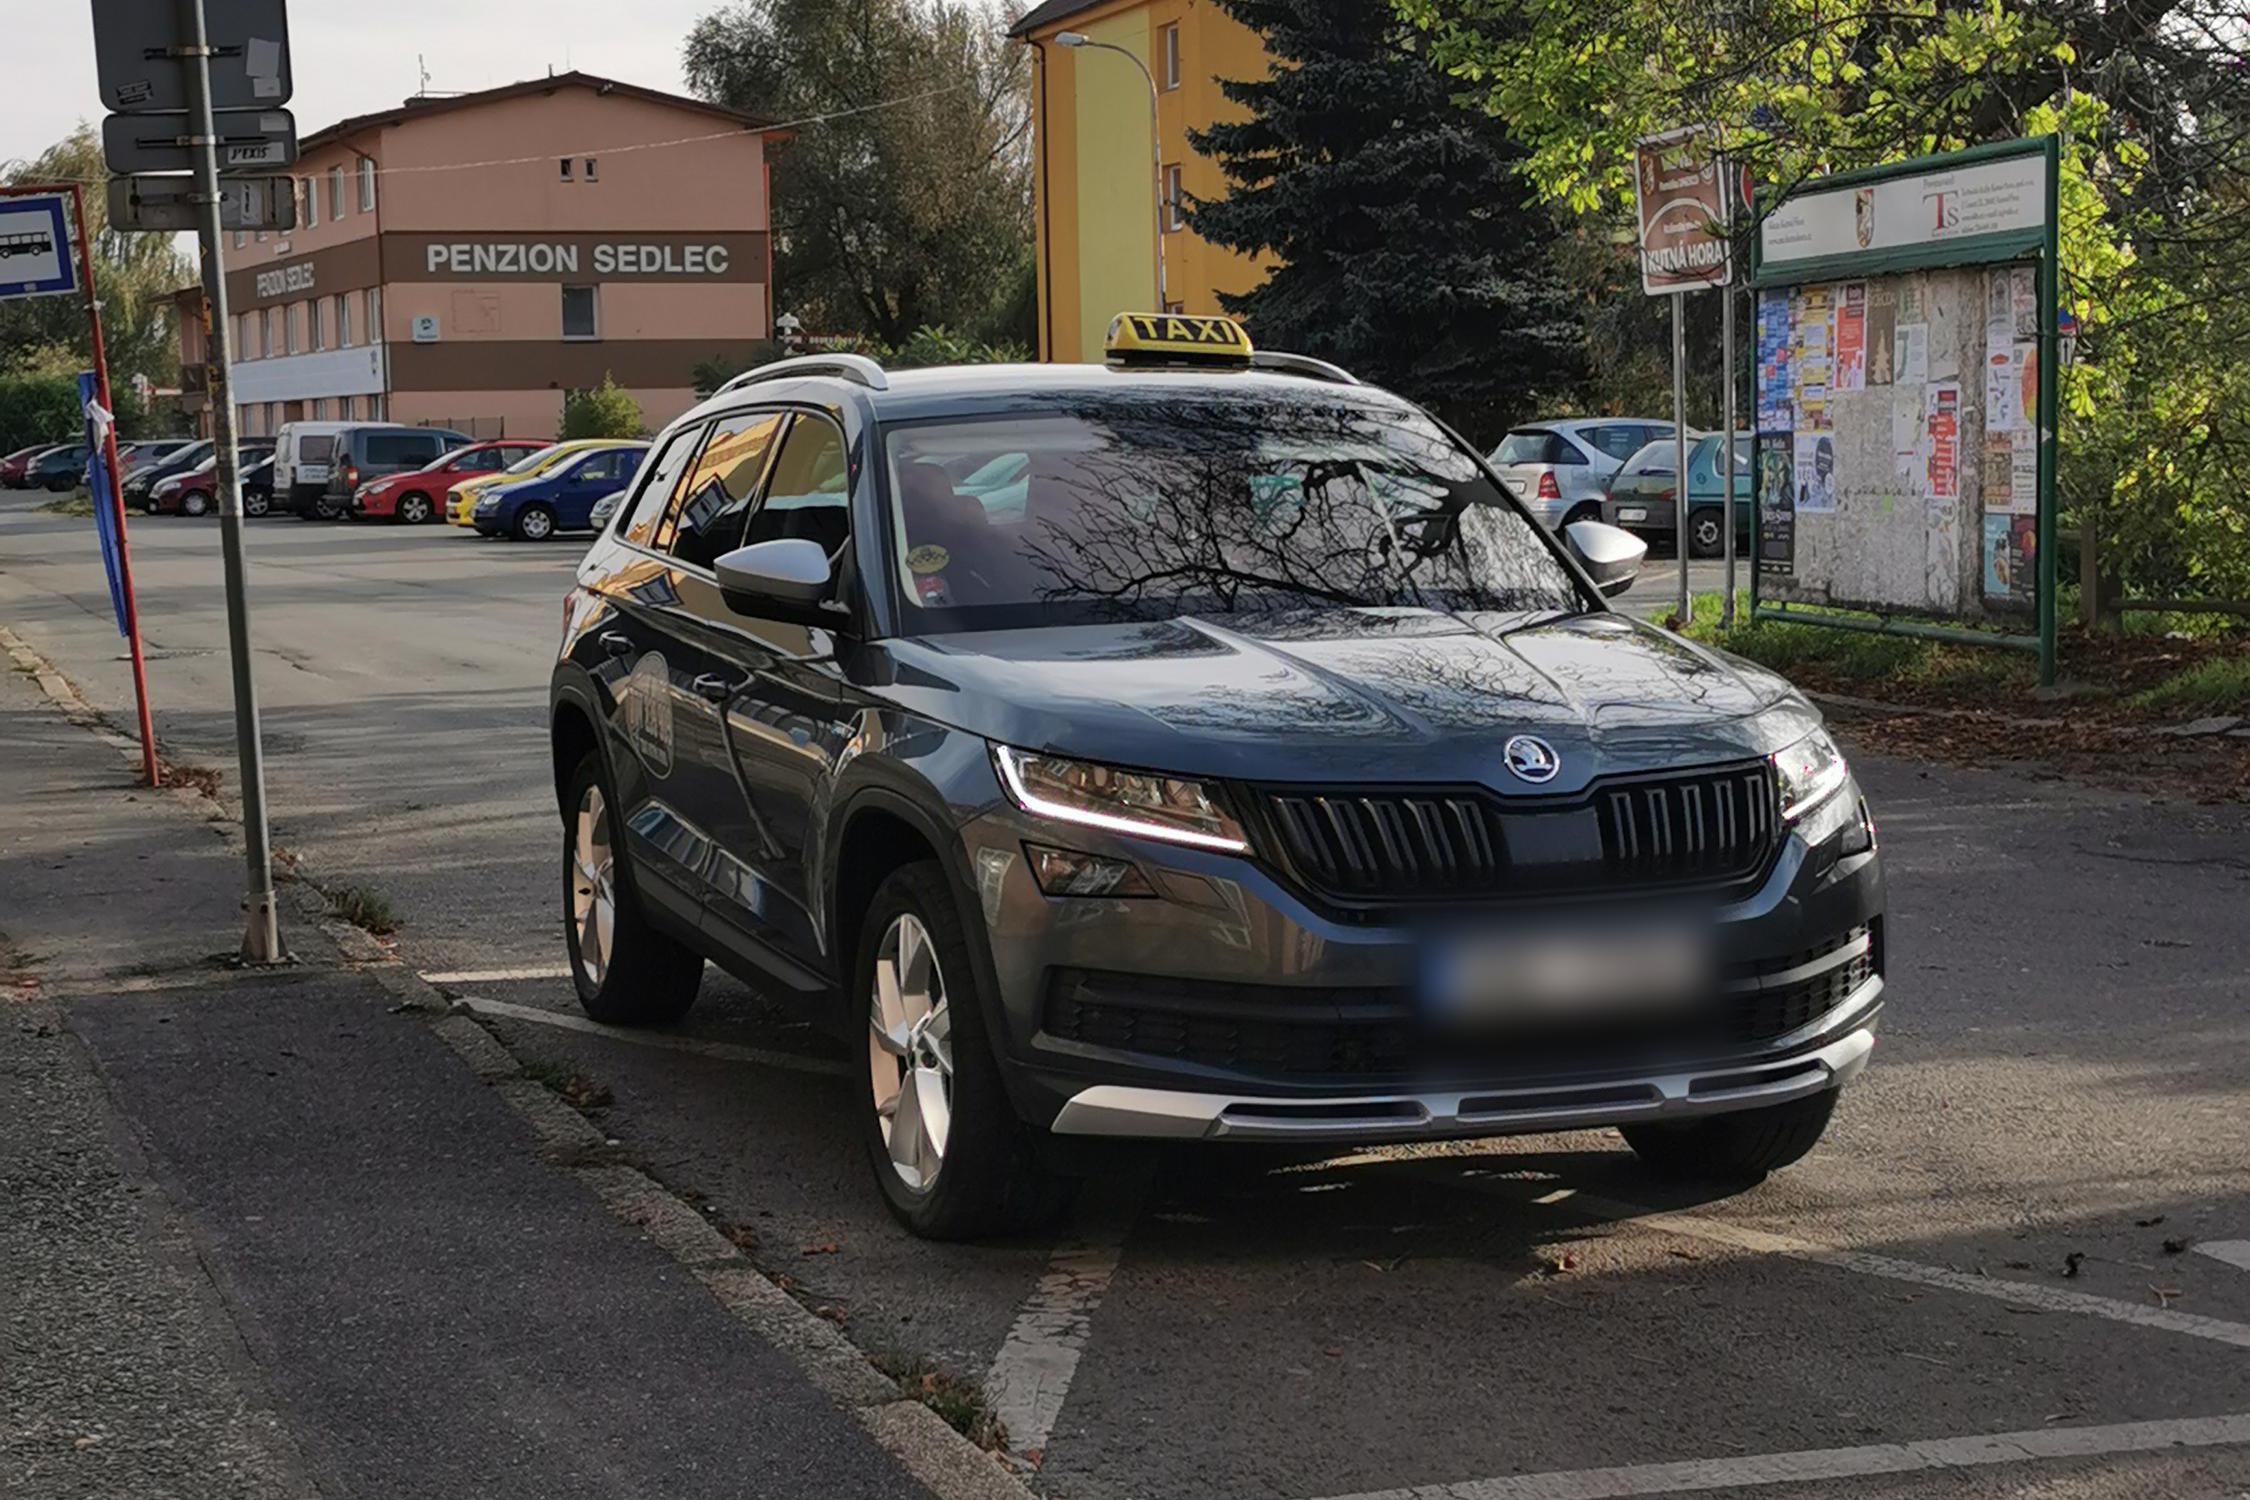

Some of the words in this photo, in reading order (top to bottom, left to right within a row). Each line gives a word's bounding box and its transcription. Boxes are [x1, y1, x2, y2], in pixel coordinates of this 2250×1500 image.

[427, 244, 579, 273] PENZION
[593, 244, 729, 273] SEDLEC
[1688, 239, 1724, 267] HORA
[1134, 317, 1236, 342] TAXI
